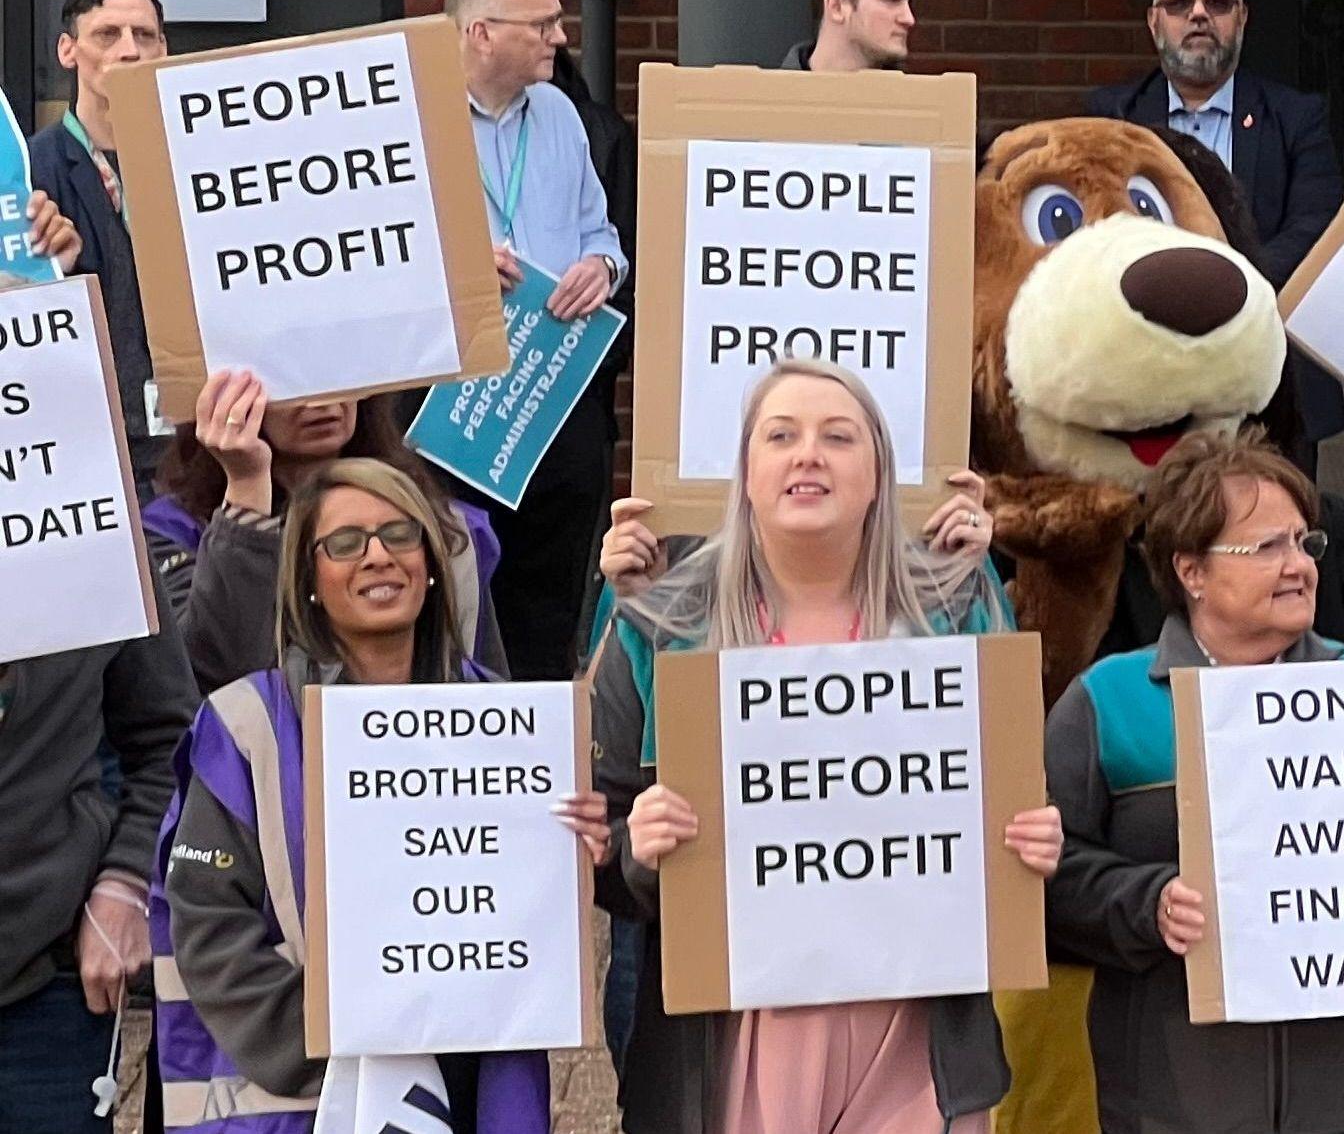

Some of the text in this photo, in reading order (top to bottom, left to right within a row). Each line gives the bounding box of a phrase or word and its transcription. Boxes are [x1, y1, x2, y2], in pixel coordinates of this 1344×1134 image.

[180, 63, 400, 134] PEOPLE
[191, 141, 415, 213] BEFORE
[705, 167, 916, 215] PEOPLE
[216, 221, 415, 290] PROFIT
[701, 246, 916, 292] BEFORE
[710, 325, 906, 370] PROFIT
[495, 348, 544, 420] FACING
[739, 665, 965, 722] PEOPLE
[362, 707, 537, 739] GORDON
[348, 764, 553, 799] BROTHERS
[740, 749, 970, 805] BEFORE
[404, 825, 500, 857] SAVE
[755, 831, 963, 888] PROFIT
[412, 885, 496, 915] OUR
[381, 940, 530, 974] STORES
